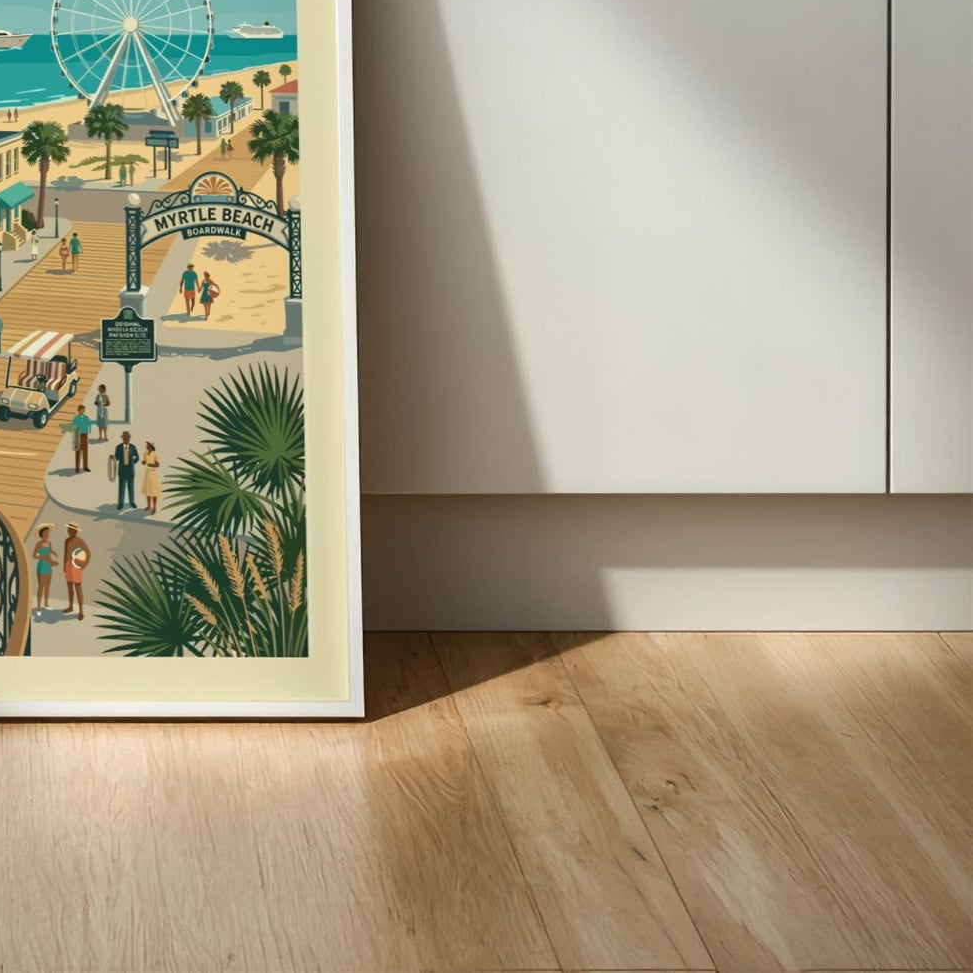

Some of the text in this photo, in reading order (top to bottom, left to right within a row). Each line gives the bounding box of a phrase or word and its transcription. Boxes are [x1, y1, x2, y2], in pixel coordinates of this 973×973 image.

[154, 208, 274, 233] MYRTLE BEACH
[187, 226, 241, 237] BOARDWALK
